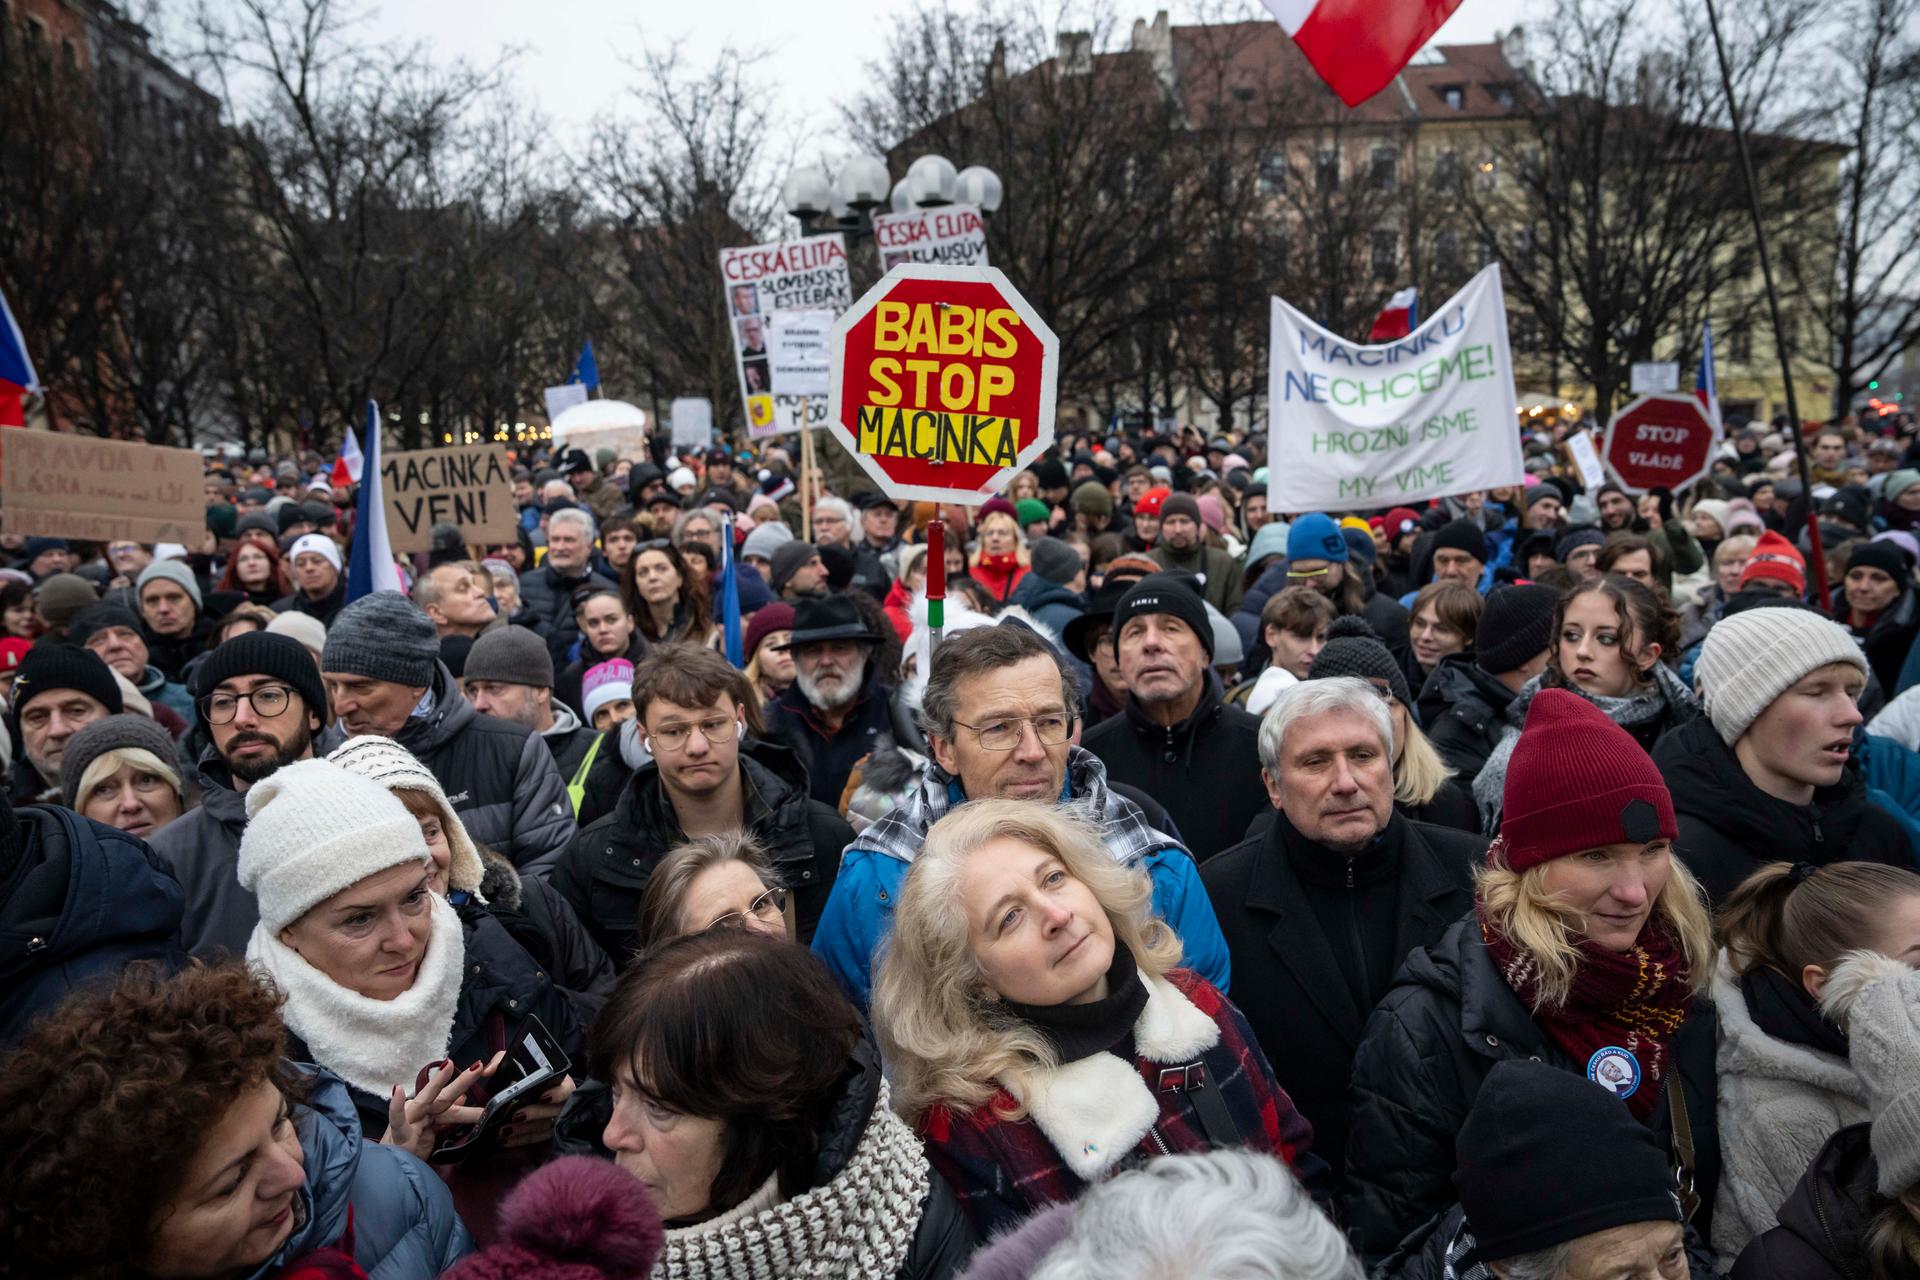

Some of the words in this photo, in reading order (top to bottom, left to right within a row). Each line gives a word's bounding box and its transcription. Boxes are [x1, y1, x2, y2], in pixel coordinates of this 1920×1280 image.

[876, 212, 931, 247] ČESKÁ
[936, 212, 986, 239] ELITA
[725, 241, 788, 281] ČESKÁ
[789, 241, 848, 272] ELITA
[875, 301, 1020, 359] BABIS
[1300, 305, 1465, 366] MACINKU
[868, 357, 1015, 412] STOP
[1285, 344, 1495, 406] NECHCEME!
[8, 433, 133, 472] PRAVDA
[152, 453, 168, 472] A
[856, 405, 1017, 467] MACINKA
[1636, 424, 1689, 444] STOP
[1339, 476, 1378, 498] MY
[394, 490, 487, 534] VEN!
